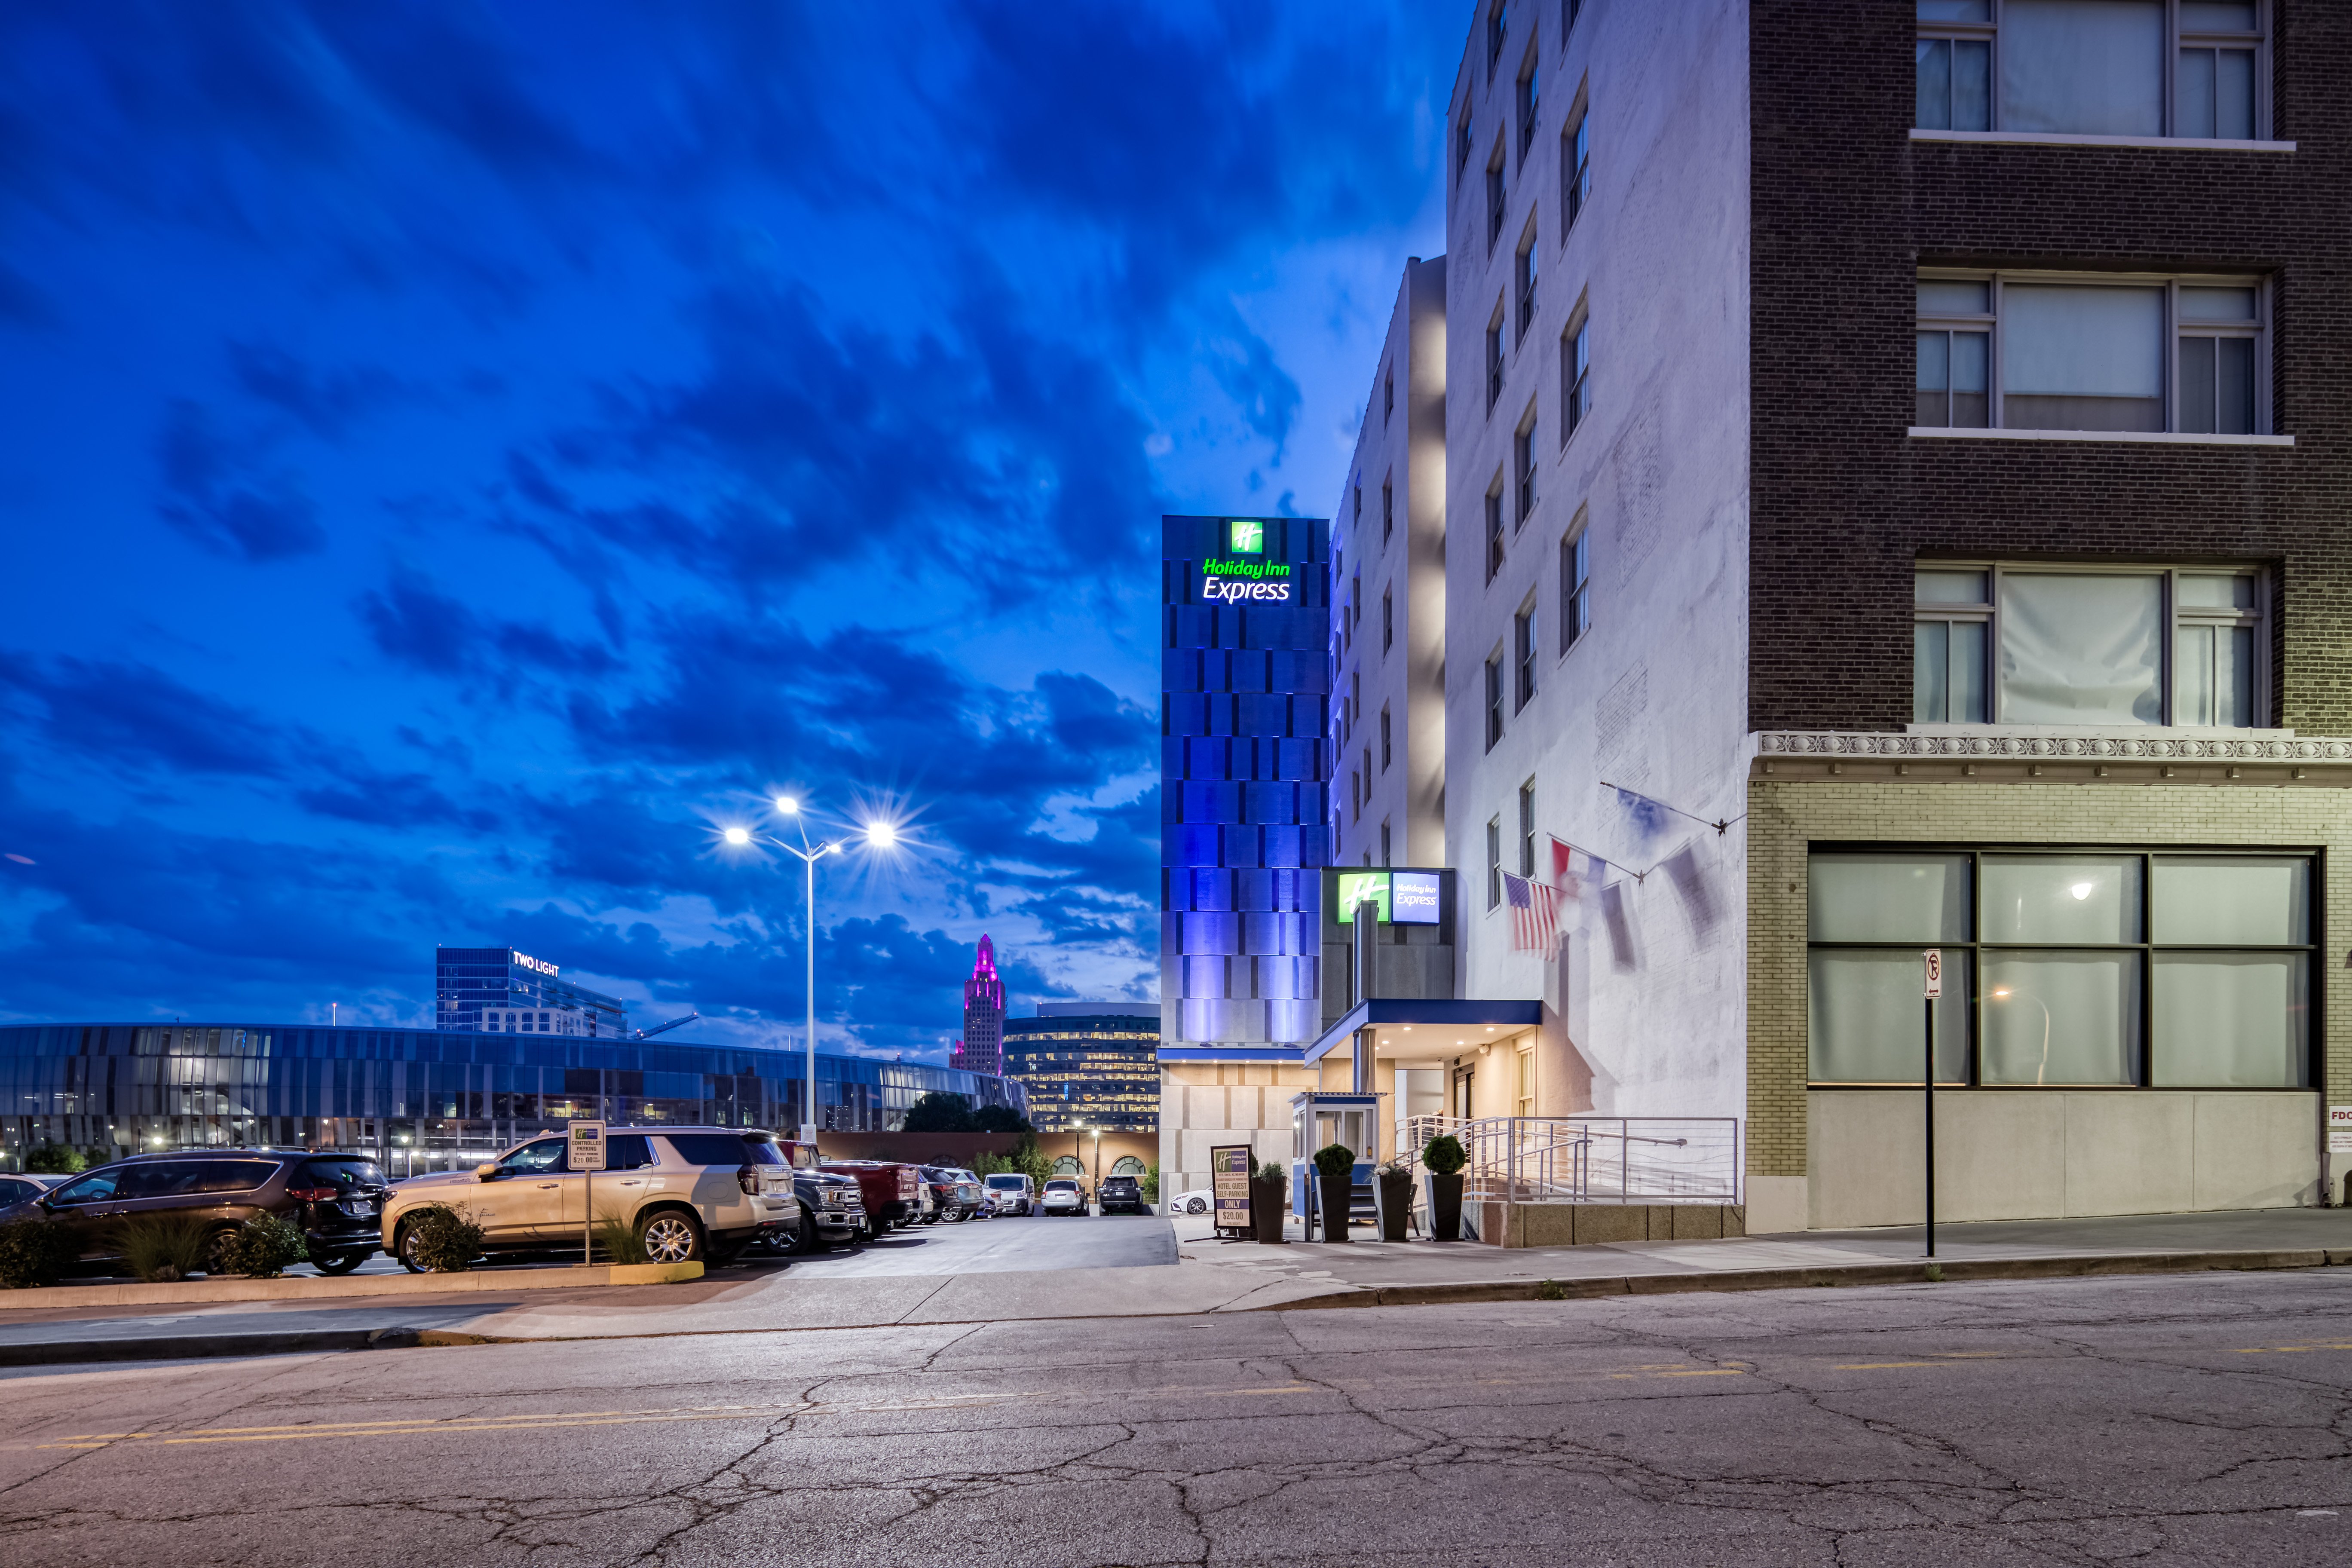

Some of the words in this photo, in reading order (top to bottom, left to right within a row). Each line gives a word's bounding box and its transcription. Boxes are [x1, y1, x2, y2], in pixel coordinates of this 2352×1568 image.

[1203, 558, 1263, 579] Holiday
[1265, 560, 1290, 576] Inn
[1203, 576, 1290, 605] Express
[1396, 883, 1424, 894] Holiday
[1425, 884, 1436, 893] Inn
[1396, 893, 1436, 906] Express
[514, 951, 534, 969] TWO
[536, 959, 559, 977] LIGHT
[1225, 1200, 1240, 1208] ONLY
[1223, 1212, 1243, 1220] $20.00
